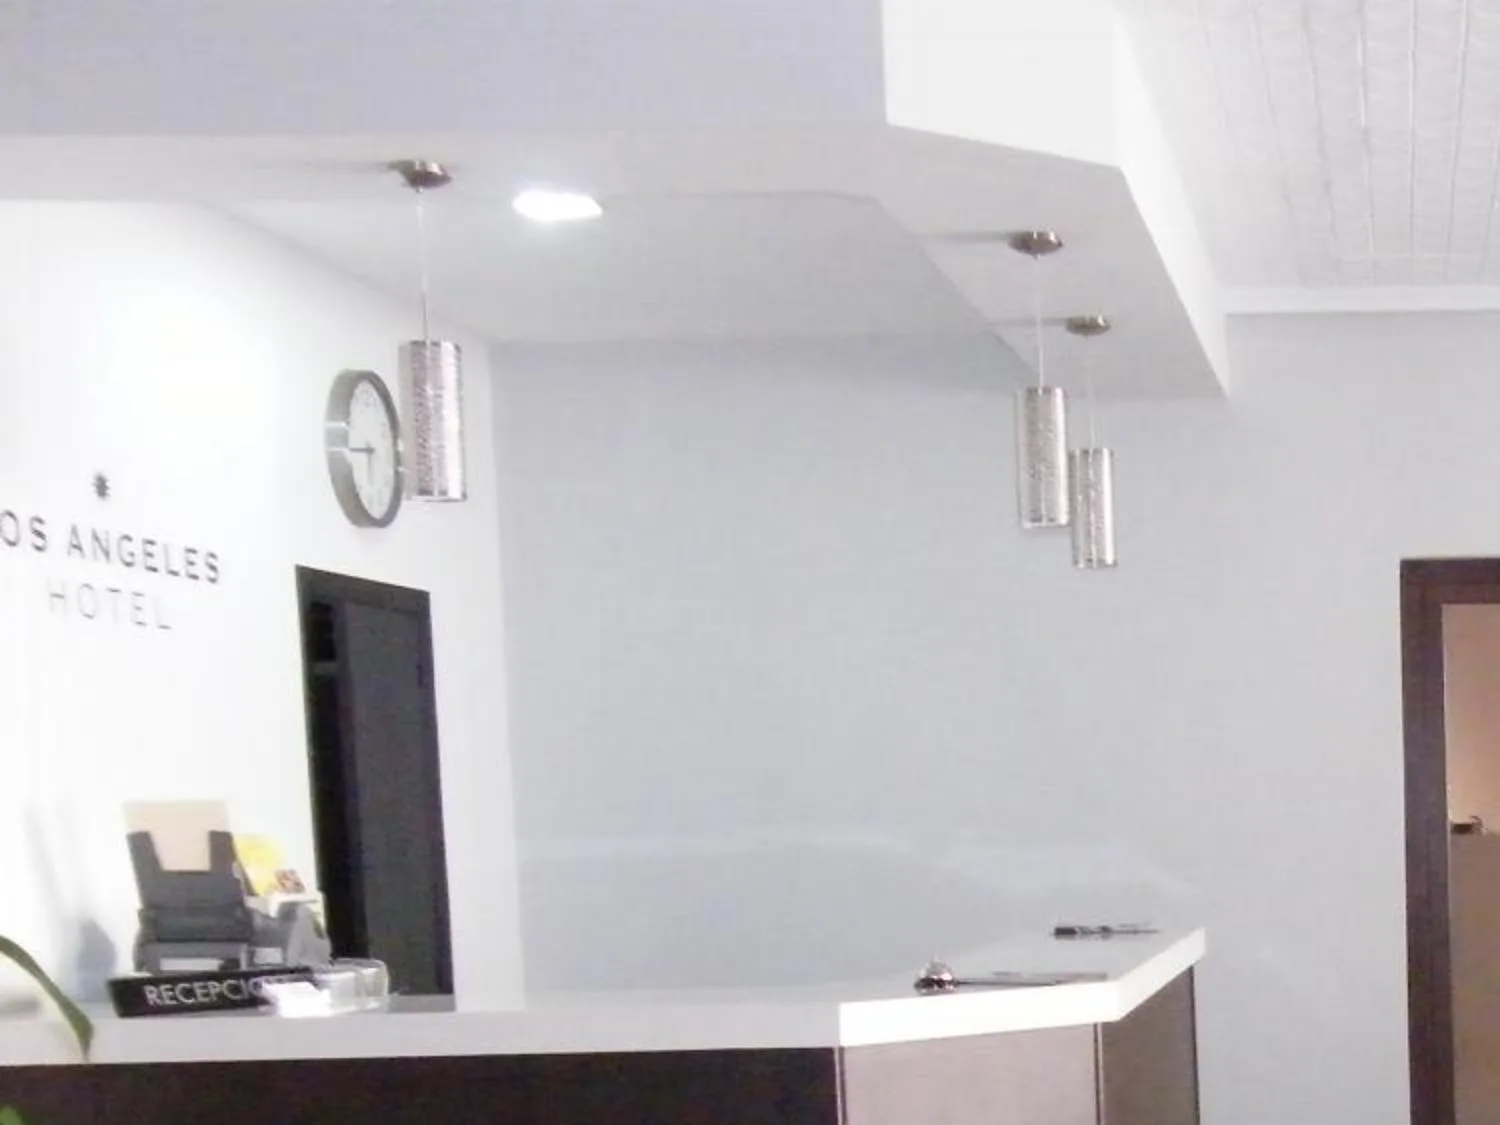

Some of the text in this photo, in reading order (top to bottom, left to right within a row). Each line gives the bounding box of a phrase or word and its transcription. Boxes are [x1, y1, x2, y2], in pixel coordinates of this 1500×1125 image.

[0, 508, 220, 585] OS ANGELES
[46, 578, 173, 631] HOTEL
